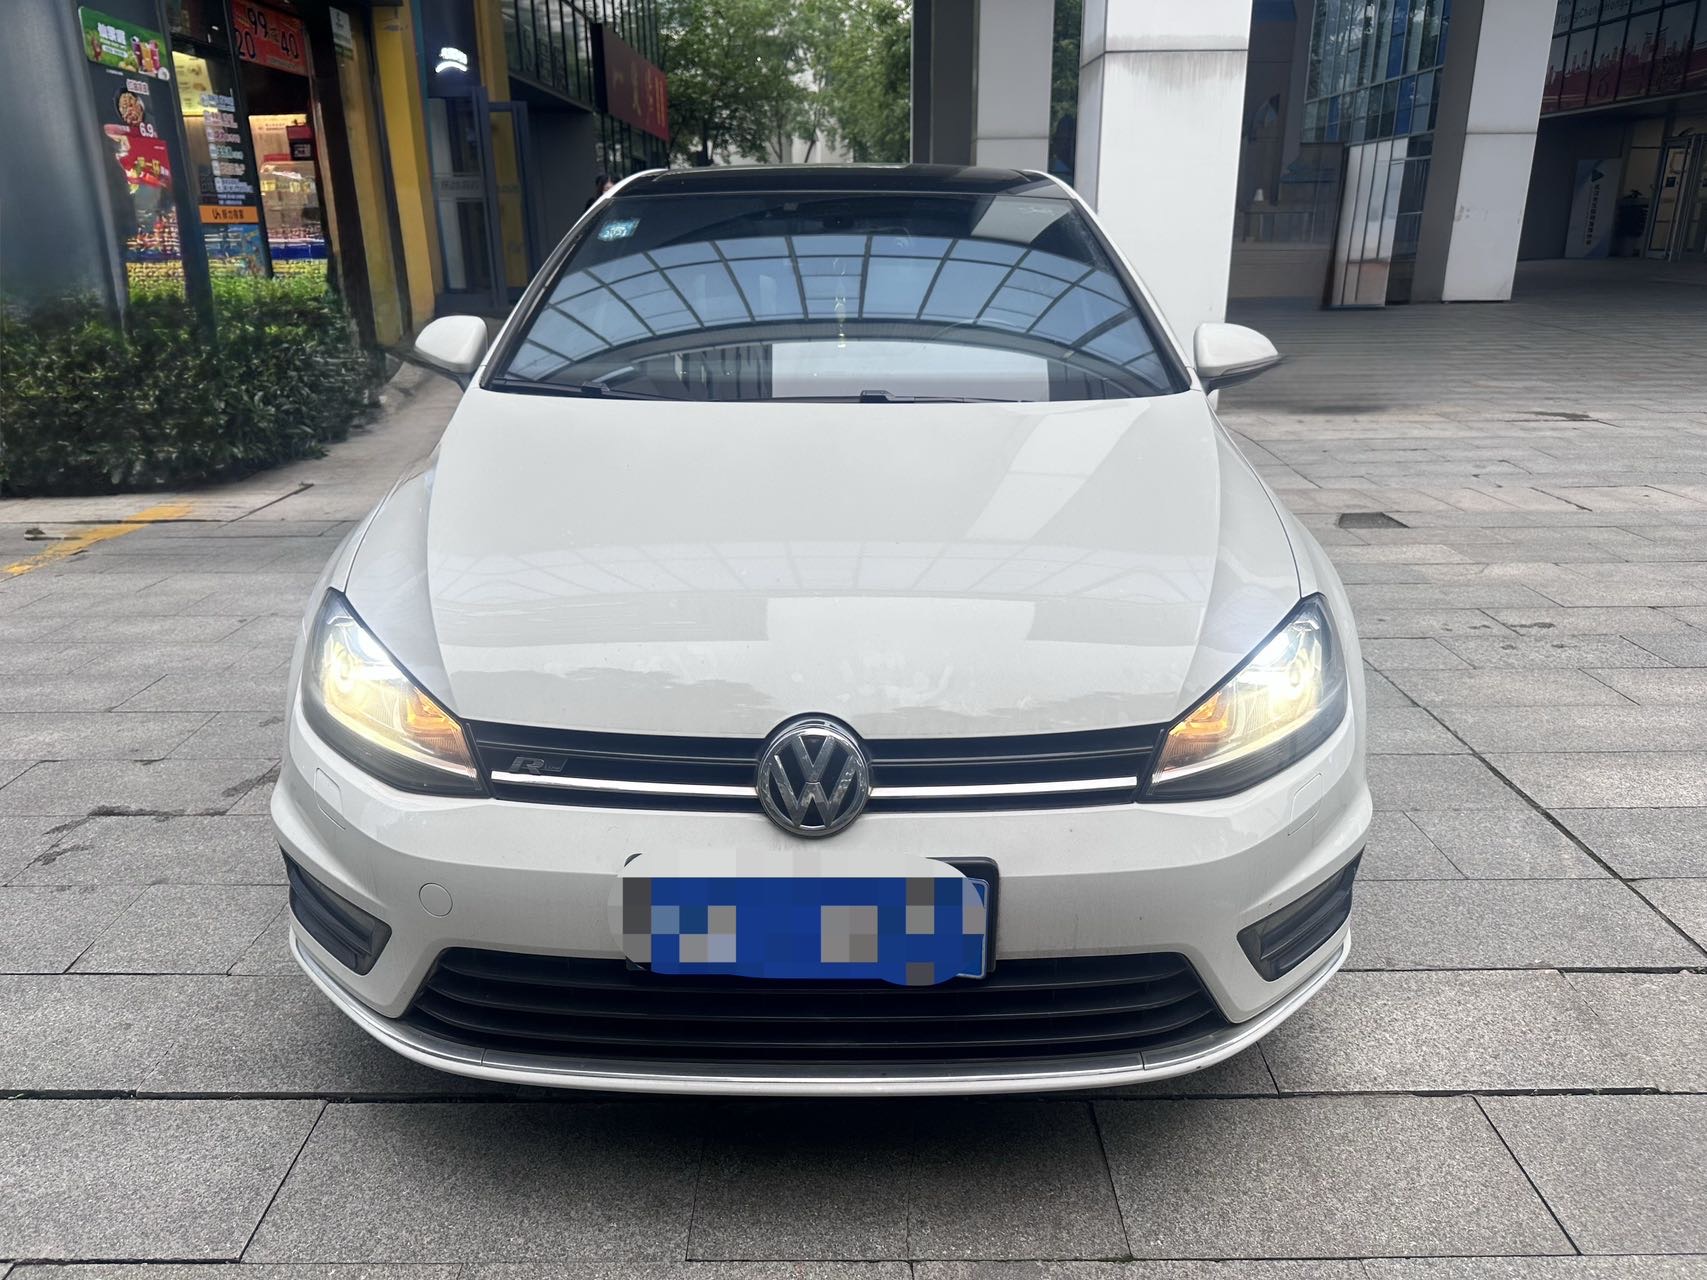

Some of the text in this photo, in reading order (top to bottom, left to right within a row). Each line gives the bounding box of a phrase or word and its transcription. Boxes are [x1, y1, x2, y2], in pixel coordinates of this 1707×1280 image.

[247, 8, 268, 38] 99
[233, 27, 256, 59] 20
[281, 31, 299, 59] 40
[139, 121, 154, 138] 6.9
[511, 756, 545, 775] R
